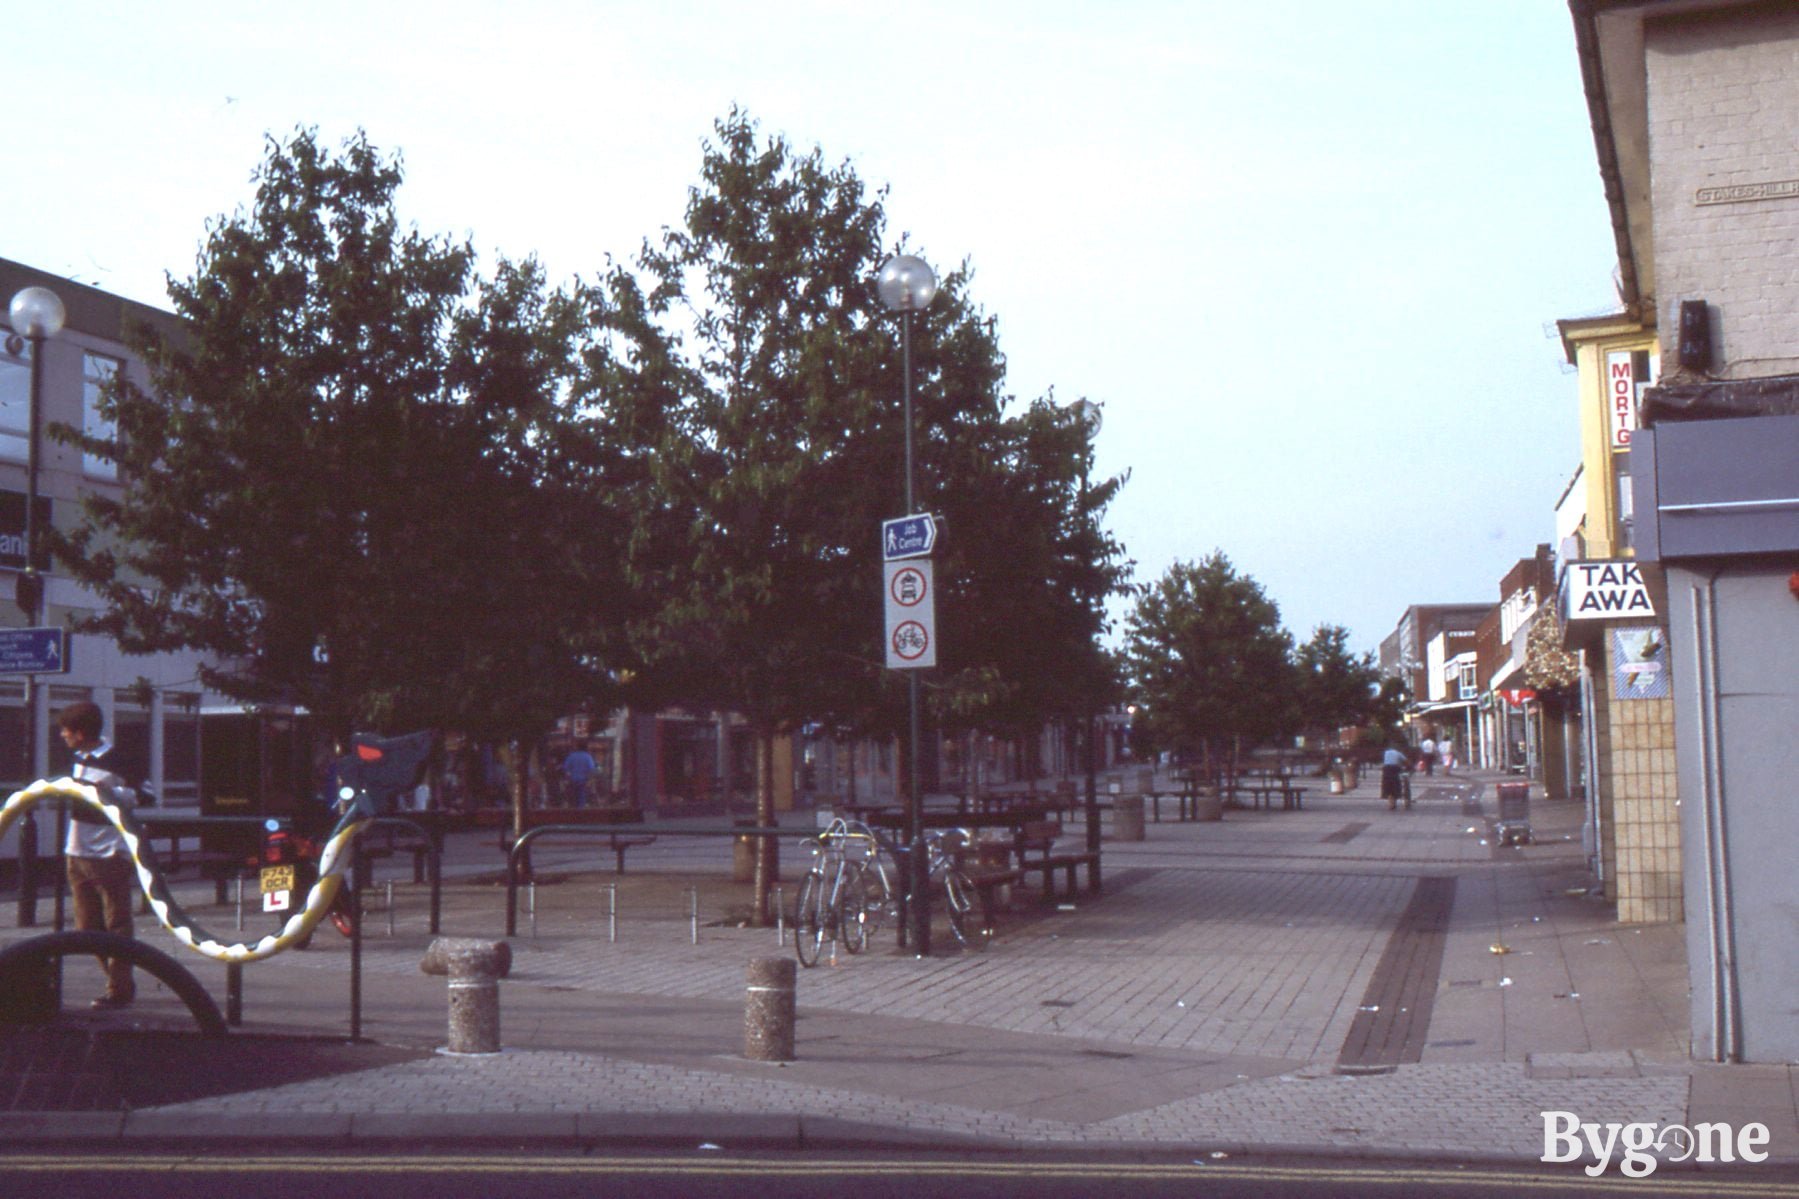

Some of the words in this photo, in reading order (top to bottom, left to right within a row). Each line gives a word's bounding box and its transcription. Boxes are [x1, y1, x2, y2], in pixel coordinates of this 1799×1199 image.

[1612, 363, 1631, 444] MORTG
[1579, 564, 1645, 587] TAK
[1579, 589, 1651, 612] AWA
